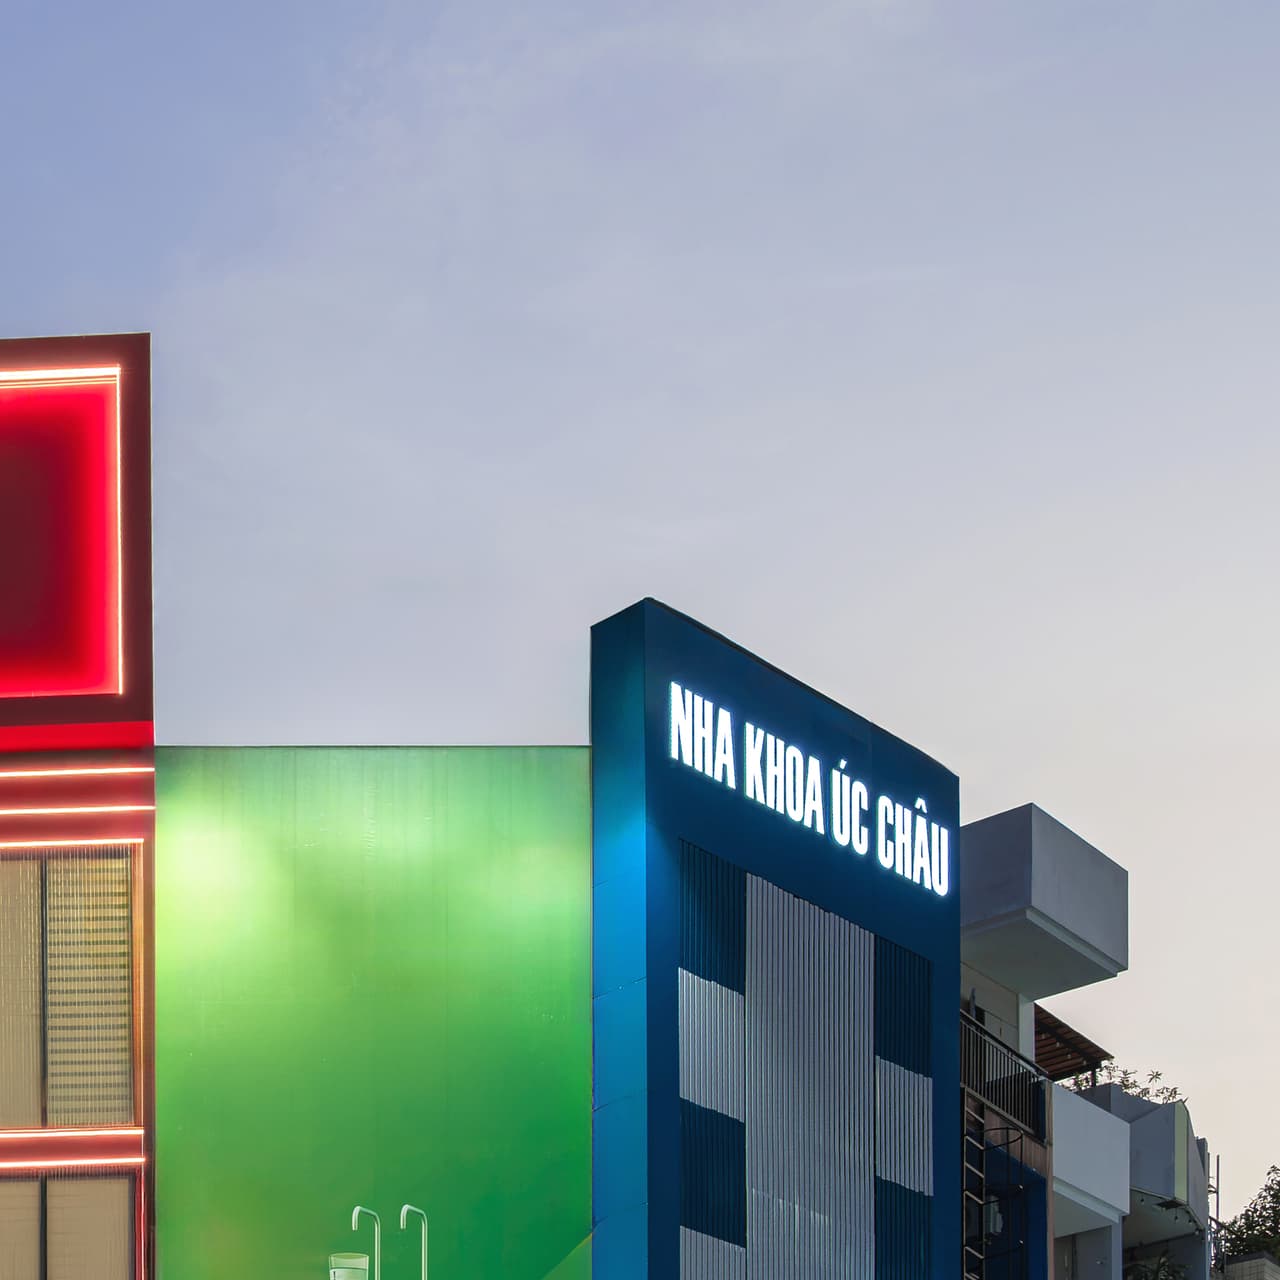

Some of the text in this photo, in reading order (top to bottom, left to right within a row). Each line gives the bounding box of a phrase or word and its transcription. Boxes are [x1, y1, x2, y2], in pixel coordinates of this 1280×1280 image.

[670, 682, 950, 897] NHA KHOA ÚC CHÂU
